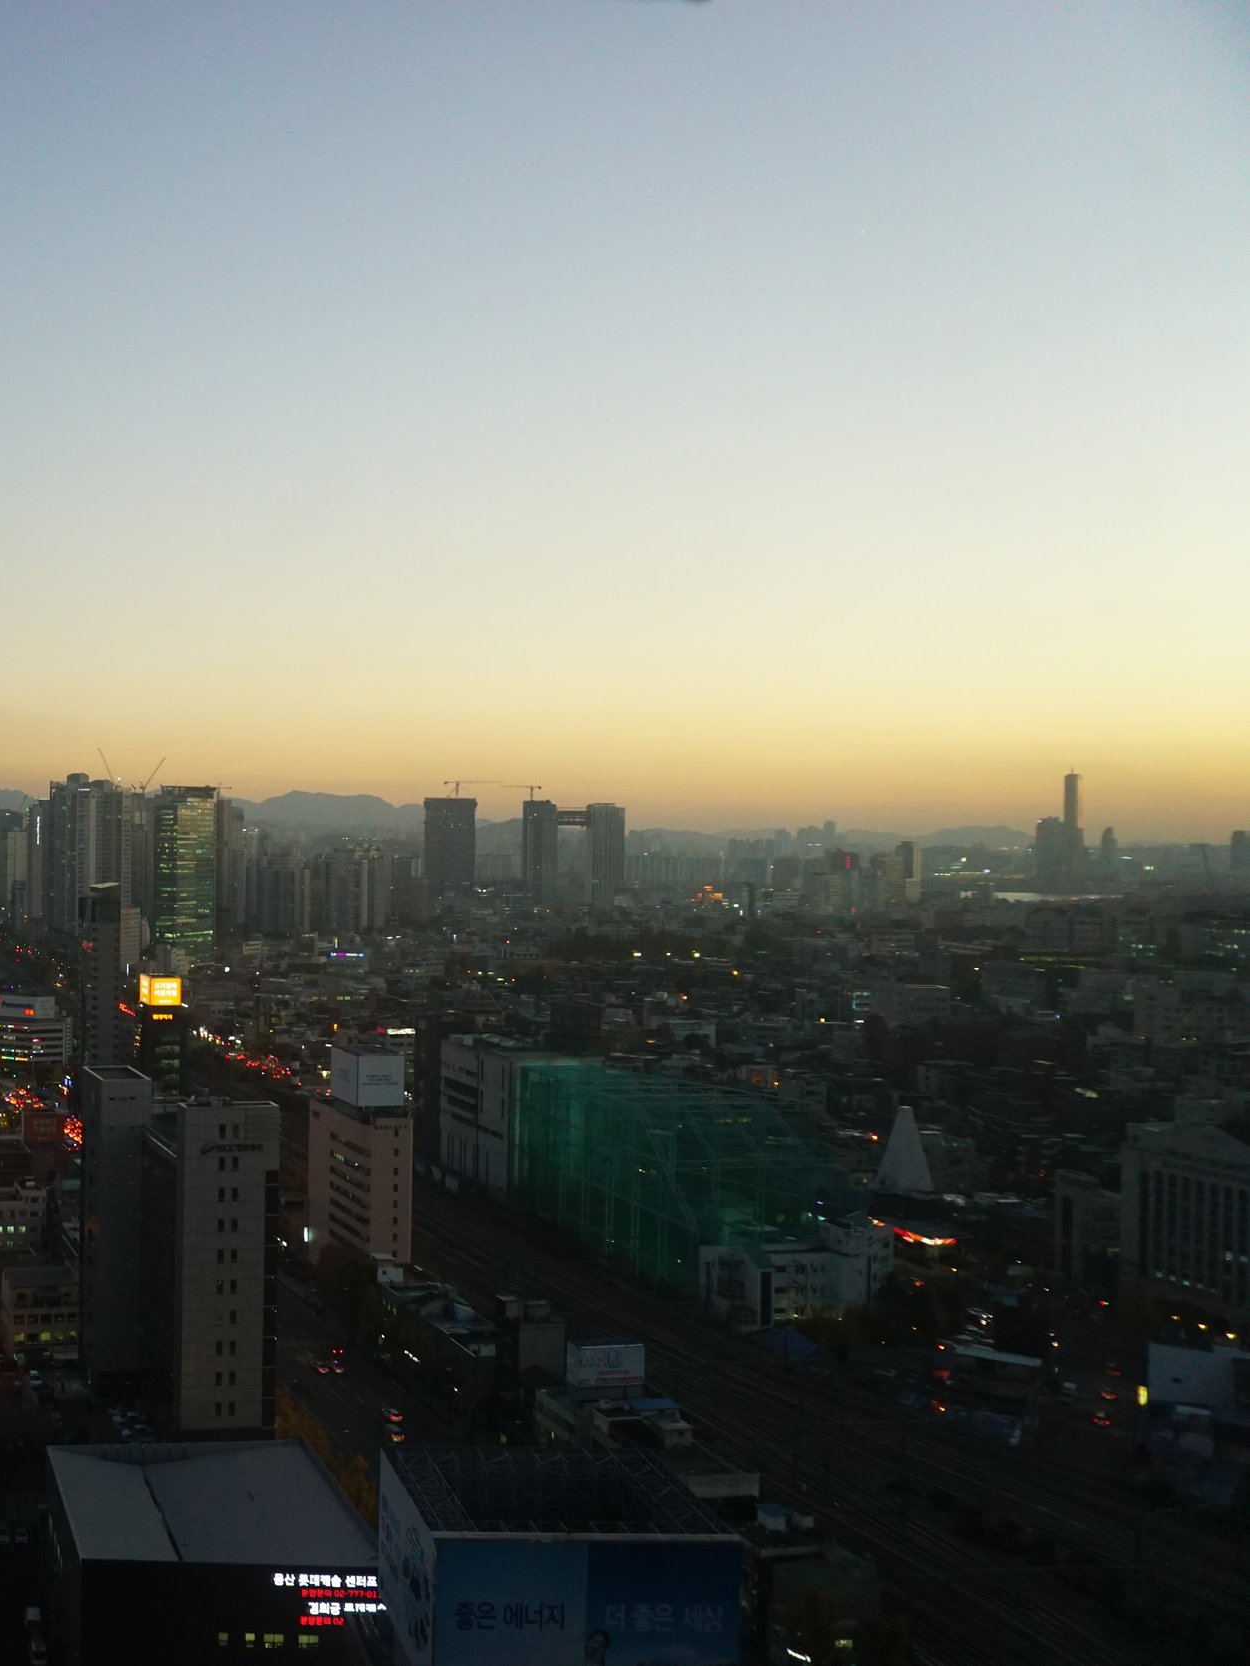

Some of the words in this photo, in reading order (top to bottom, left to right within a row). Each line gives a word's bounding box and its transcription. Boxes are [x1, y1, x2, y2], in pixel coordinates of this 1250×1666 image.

[273, 1573, 295, 1586] 용산
[298, 1574, 342, 1587] 롯데캐슬
[454, 1602, 496, 1630] 좋은
[503, 1601, 565, 1630] 에너지
[605, 1603, 625, 1632] 더
[631, 1604, 674, 1632] 좋은
[681, 1603, 723, 1633] 세상
